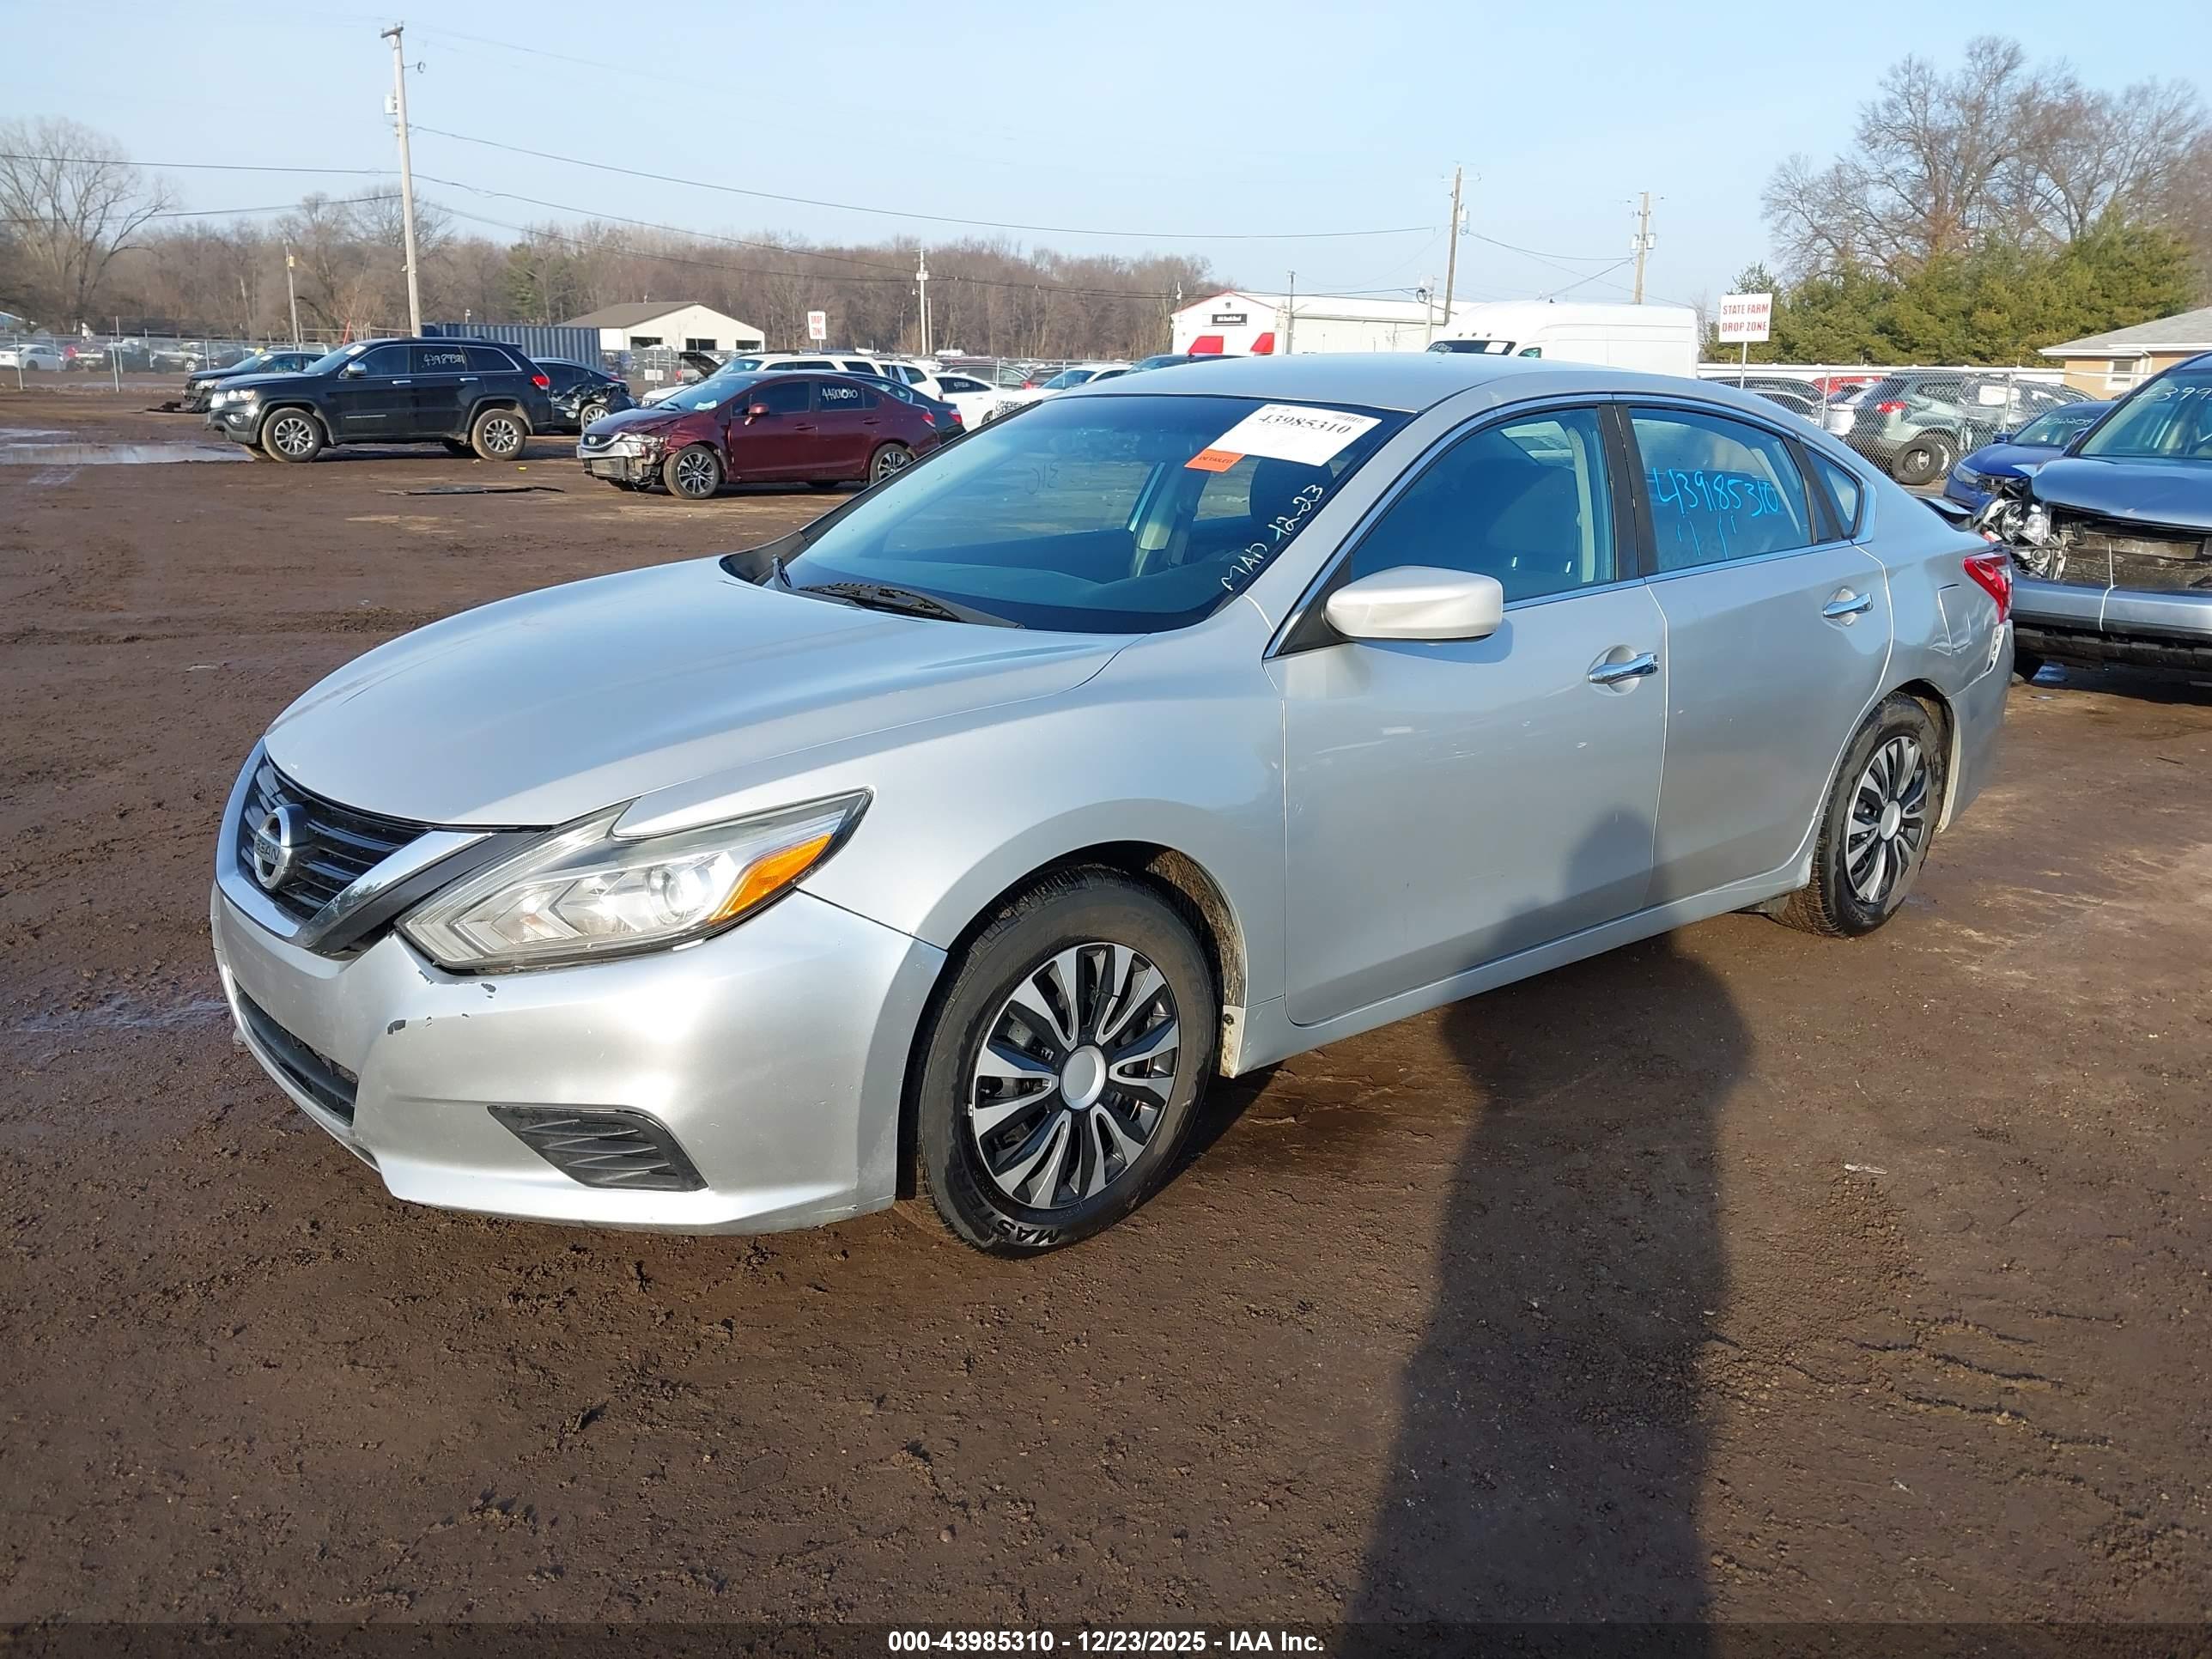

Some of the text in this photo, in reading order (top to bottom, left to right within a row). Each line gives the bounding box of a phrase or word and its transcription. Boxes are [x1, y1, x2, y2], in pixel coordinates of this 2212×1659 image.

[1723, 303, 1769, 315] STATE FARM
[1722, 320, 1767, 332] DROP ZONE
[2133, 386, 2212, 403] 4399
[1259, 413, 1352, 434] 43985310
